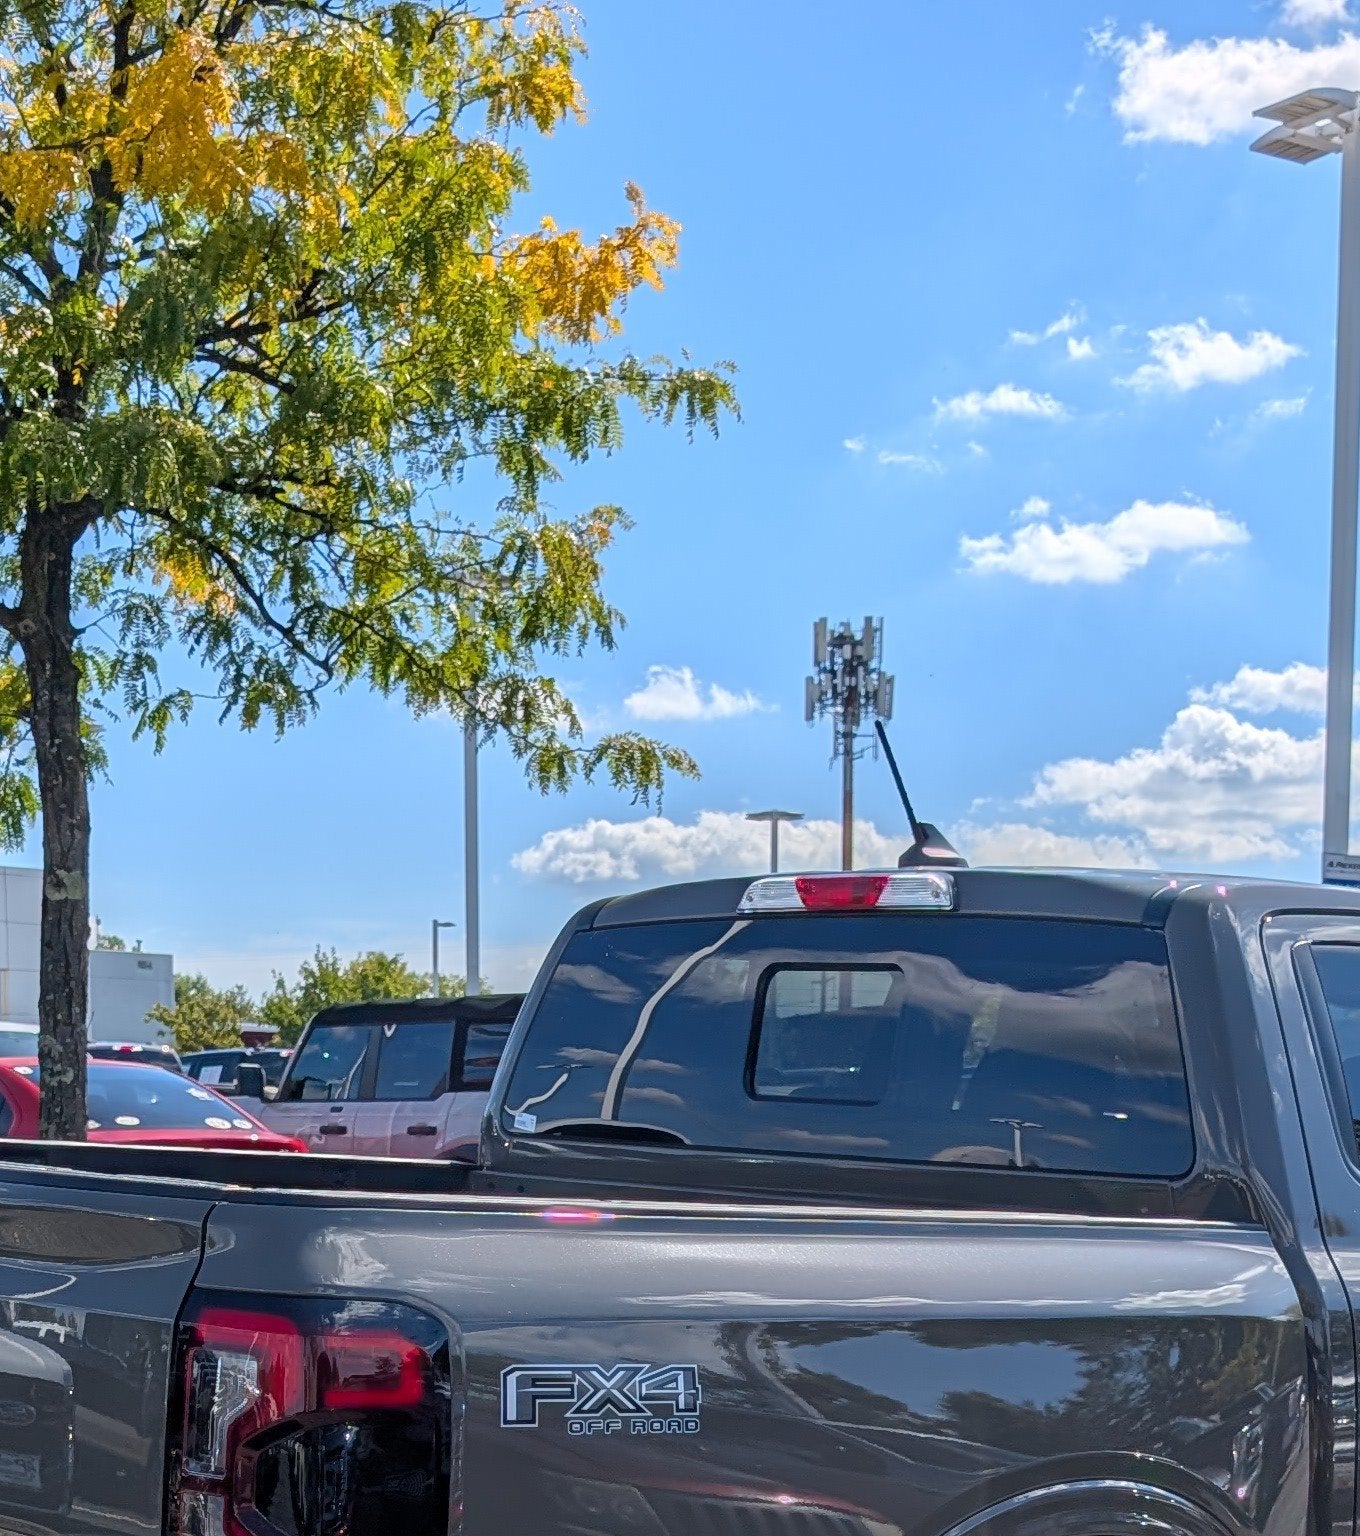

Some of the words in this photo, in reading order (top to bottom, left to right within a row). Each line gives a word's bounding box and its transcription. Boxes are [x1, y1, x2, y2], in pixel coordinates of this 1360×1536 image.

[499, 1363, 702, 1428] FX4
[567, 1419, 623, 1436] OFF
[630, 1418, 700, 1435] ROAD
